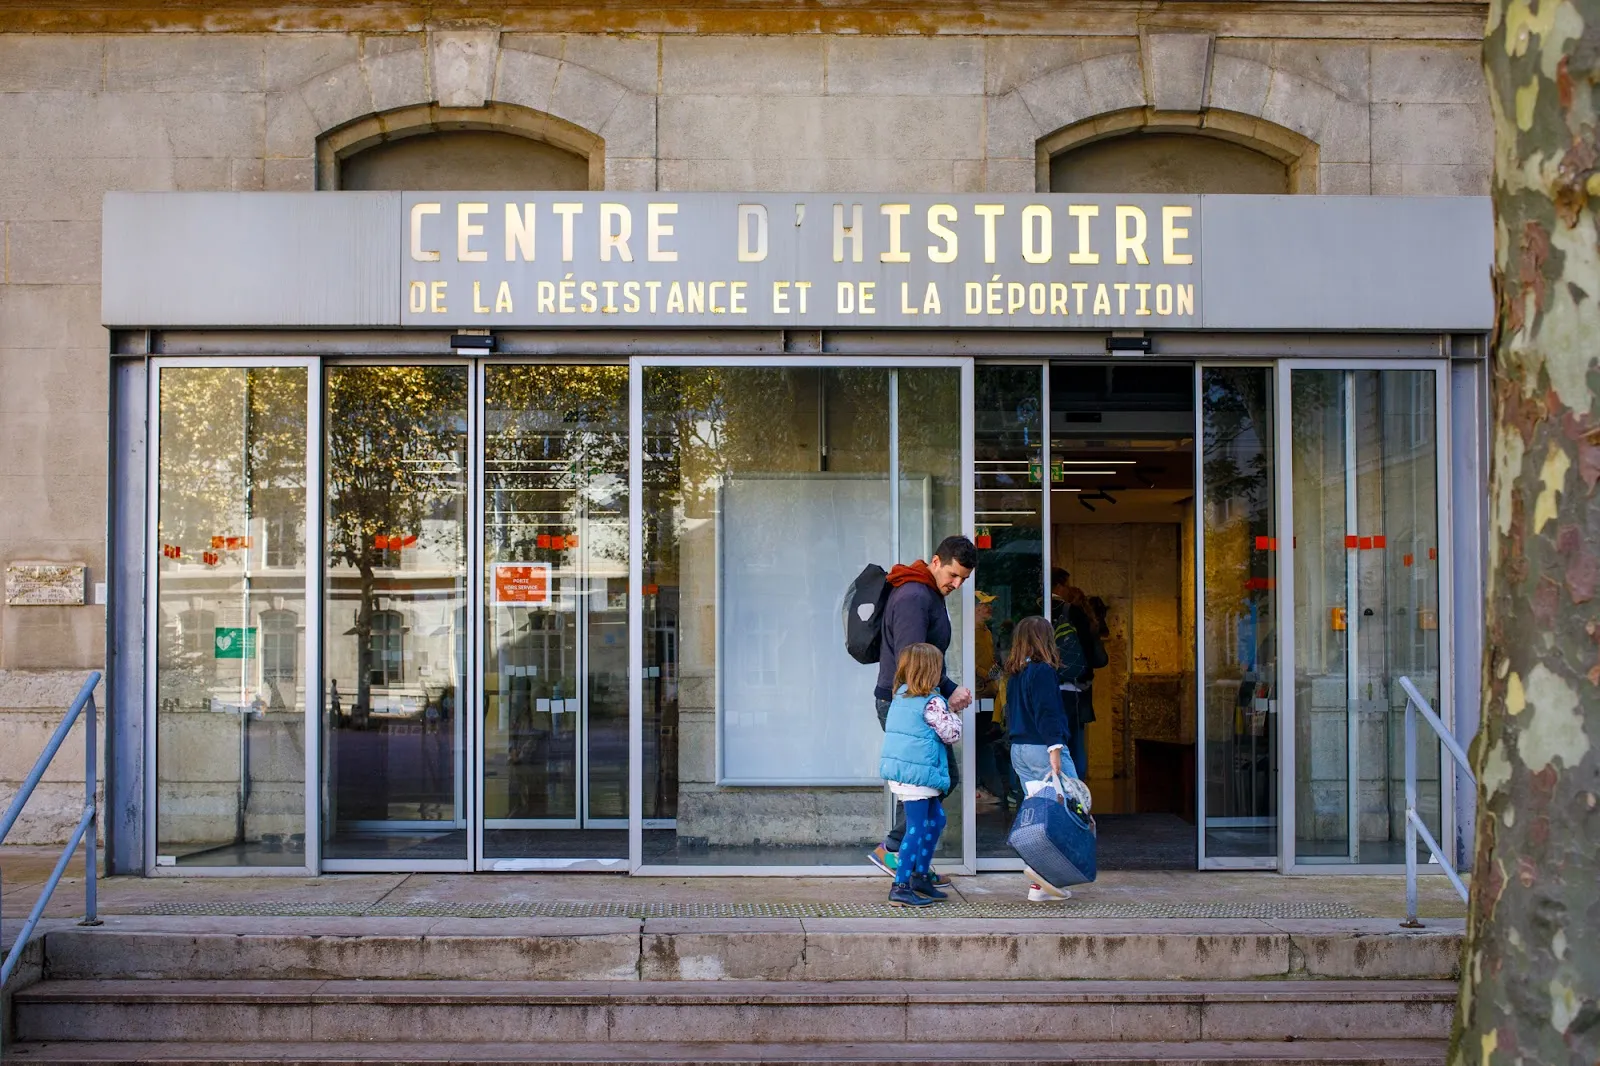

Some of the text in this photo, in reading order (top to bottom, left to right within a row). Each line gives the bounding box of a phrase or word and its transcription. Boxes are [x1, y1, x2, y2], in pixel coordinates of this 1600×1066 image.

[410, 202, 1194, 265] CENTRE D'HISTOIRE
[409, 273, 1195, 317] DE LA RÉSISTANCE ET DE LA DÉPORTATION
